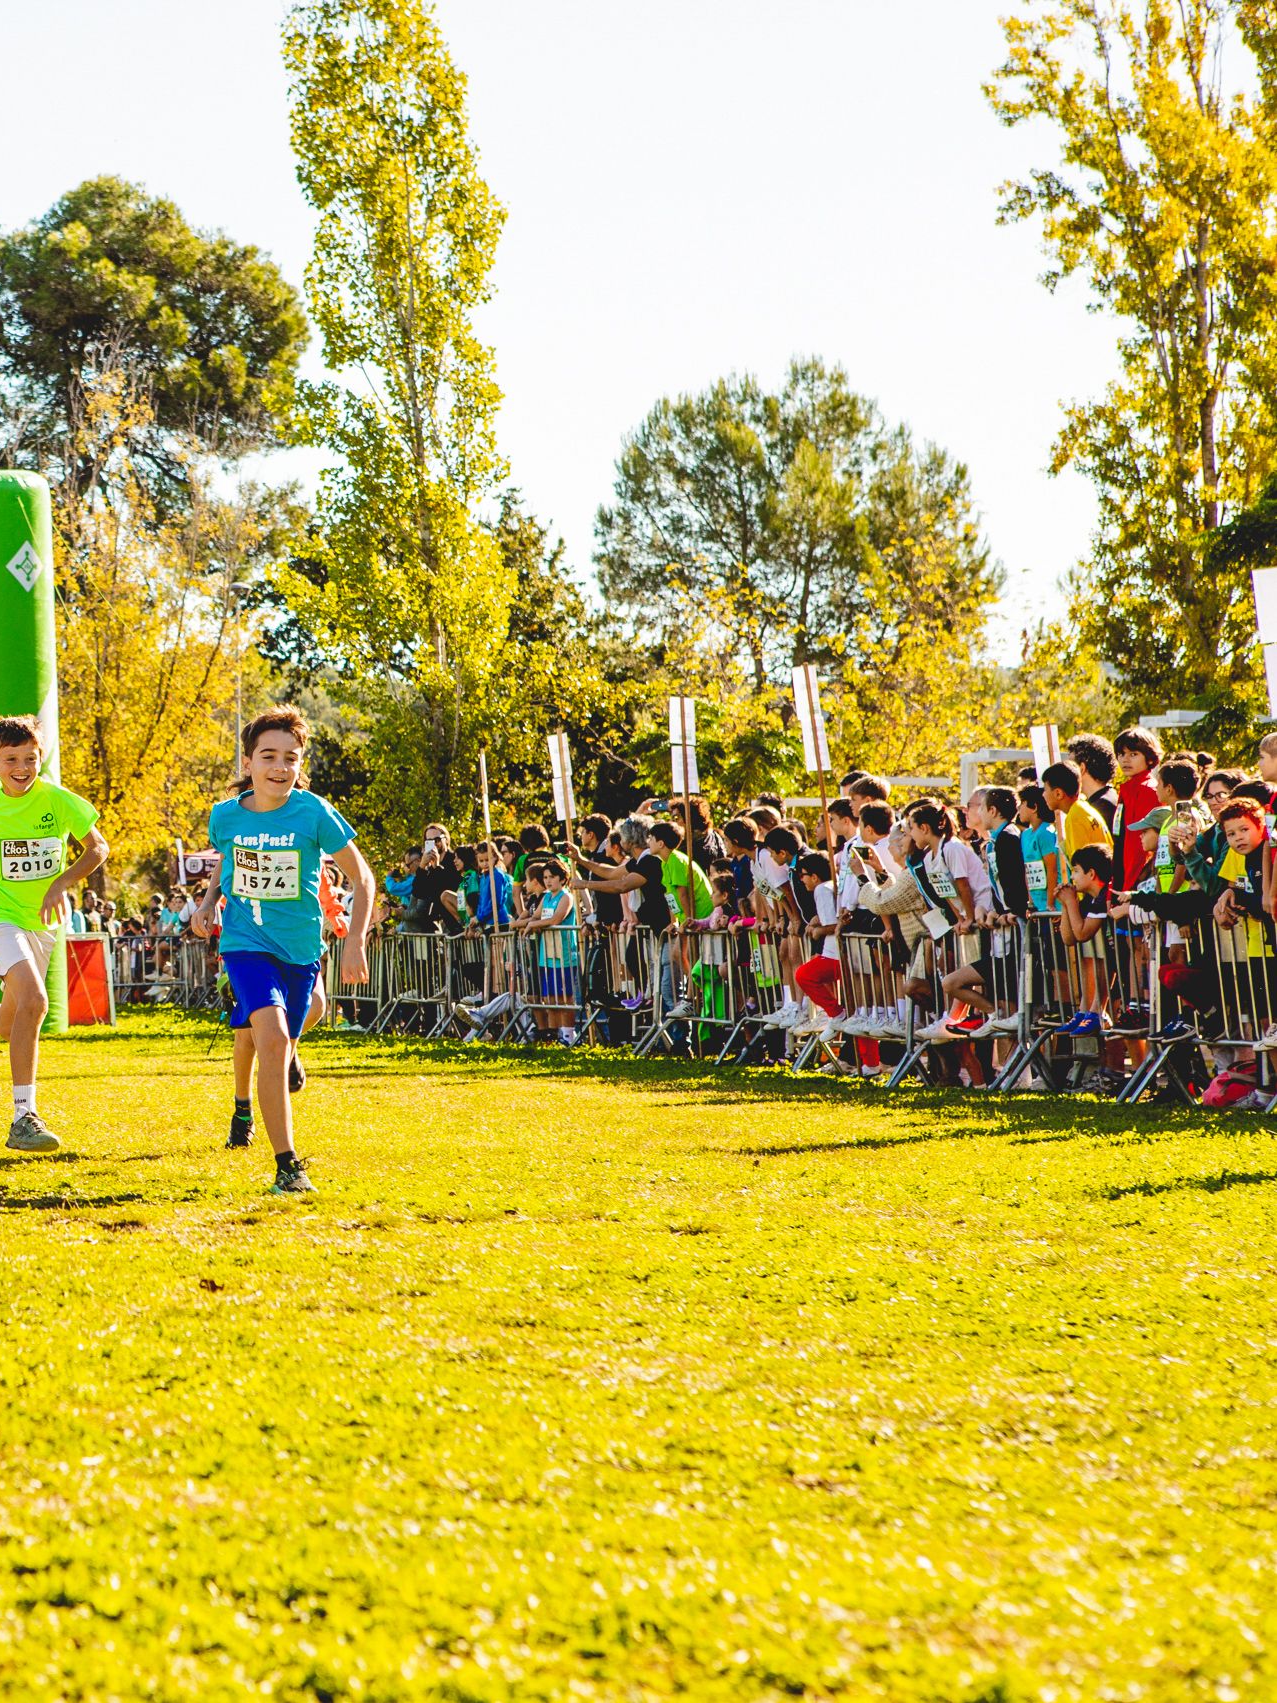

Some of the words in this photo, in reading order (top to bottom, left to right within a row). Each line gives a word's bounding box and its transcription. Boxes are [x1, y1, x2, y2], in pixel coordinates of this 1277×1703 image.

[4, 847, 28, 855] CROS
[9, 858, 53, 873] 2010
[237, 857, 258, 868] CROS
[242, 873, 286, 889] 1574
